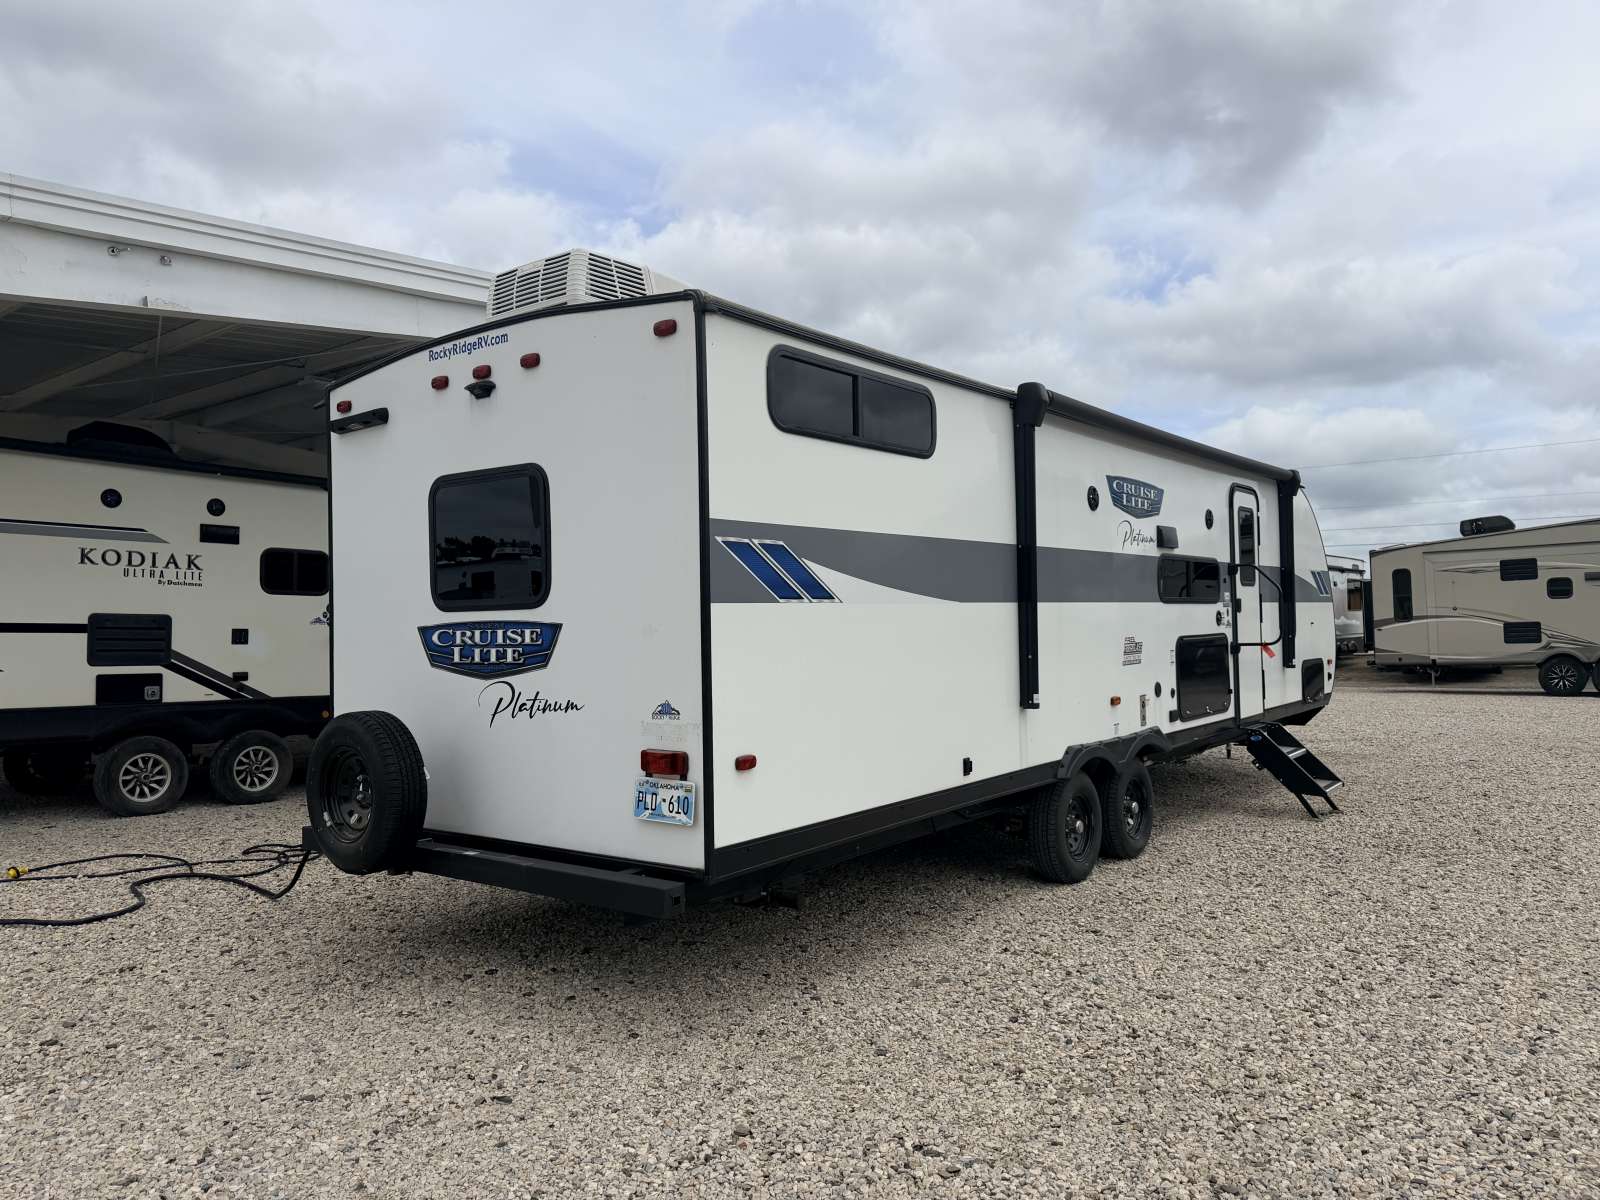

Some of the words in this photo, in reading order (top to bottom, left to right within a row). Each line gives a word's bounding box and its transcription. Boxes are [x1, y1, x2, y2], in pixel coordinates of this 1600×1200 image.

[428, 333, 509, 361] RockyRidgeRV.com
[1113, 480, 1158, 500] CRUISE
[1122, 493, 1152, 511] LITE
[1117, 520, 1156, 550] Platinum
[78, 547, 203, 571] KODIAK
[123, 568, 165, 579] ULTRA
[176, 571, 202, 581] LITE
[431, 628, 543, 646] CRUISE
[451, 646, 524, 664] LITE
[478, 680, 584, 728] Platinum
[650, 781, 680, 791] OKLAHOMA
[636, 790, 658, 812] PLD
[668, 795, 690, 816] 610
